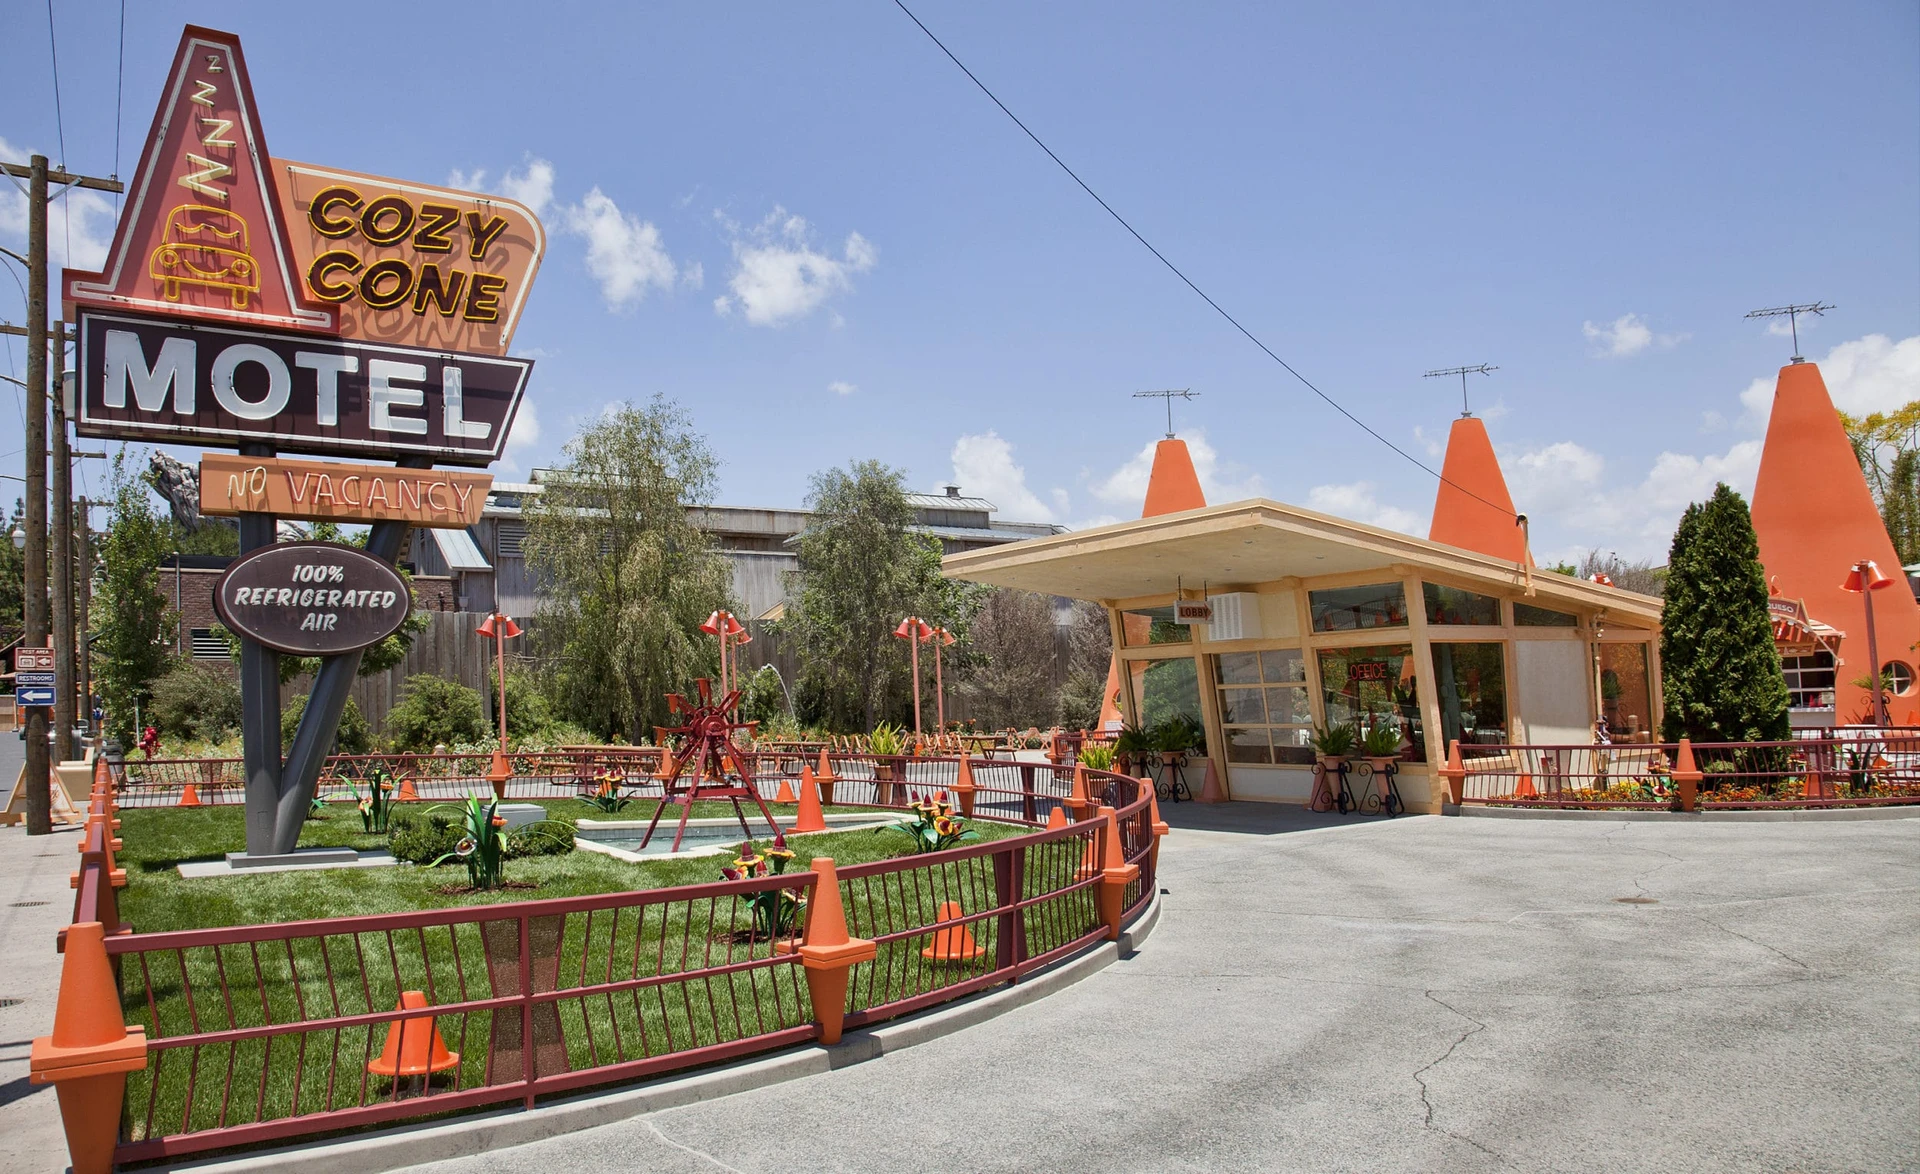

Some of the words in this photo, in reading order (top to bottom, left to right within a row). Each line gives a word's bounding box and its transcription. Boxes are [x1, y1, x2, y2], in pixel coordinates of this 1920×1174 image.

[307, 184, 509, 259] COZY
[306, 249, 508, 321] CONE
[103, 329, 493, 440] MOTEL
[227, 466, 267, 498] NO
[283, 470, 473, 513] VACANCY
[291, 564, 344, 584] 100%
[233, 587, 397, 609] REFRIGERATED
[299, 613, 338, 632] AIR
[1180, 607, 1208, 617] LOBBY
[1350, 663, 1387, 680] OFFICE
